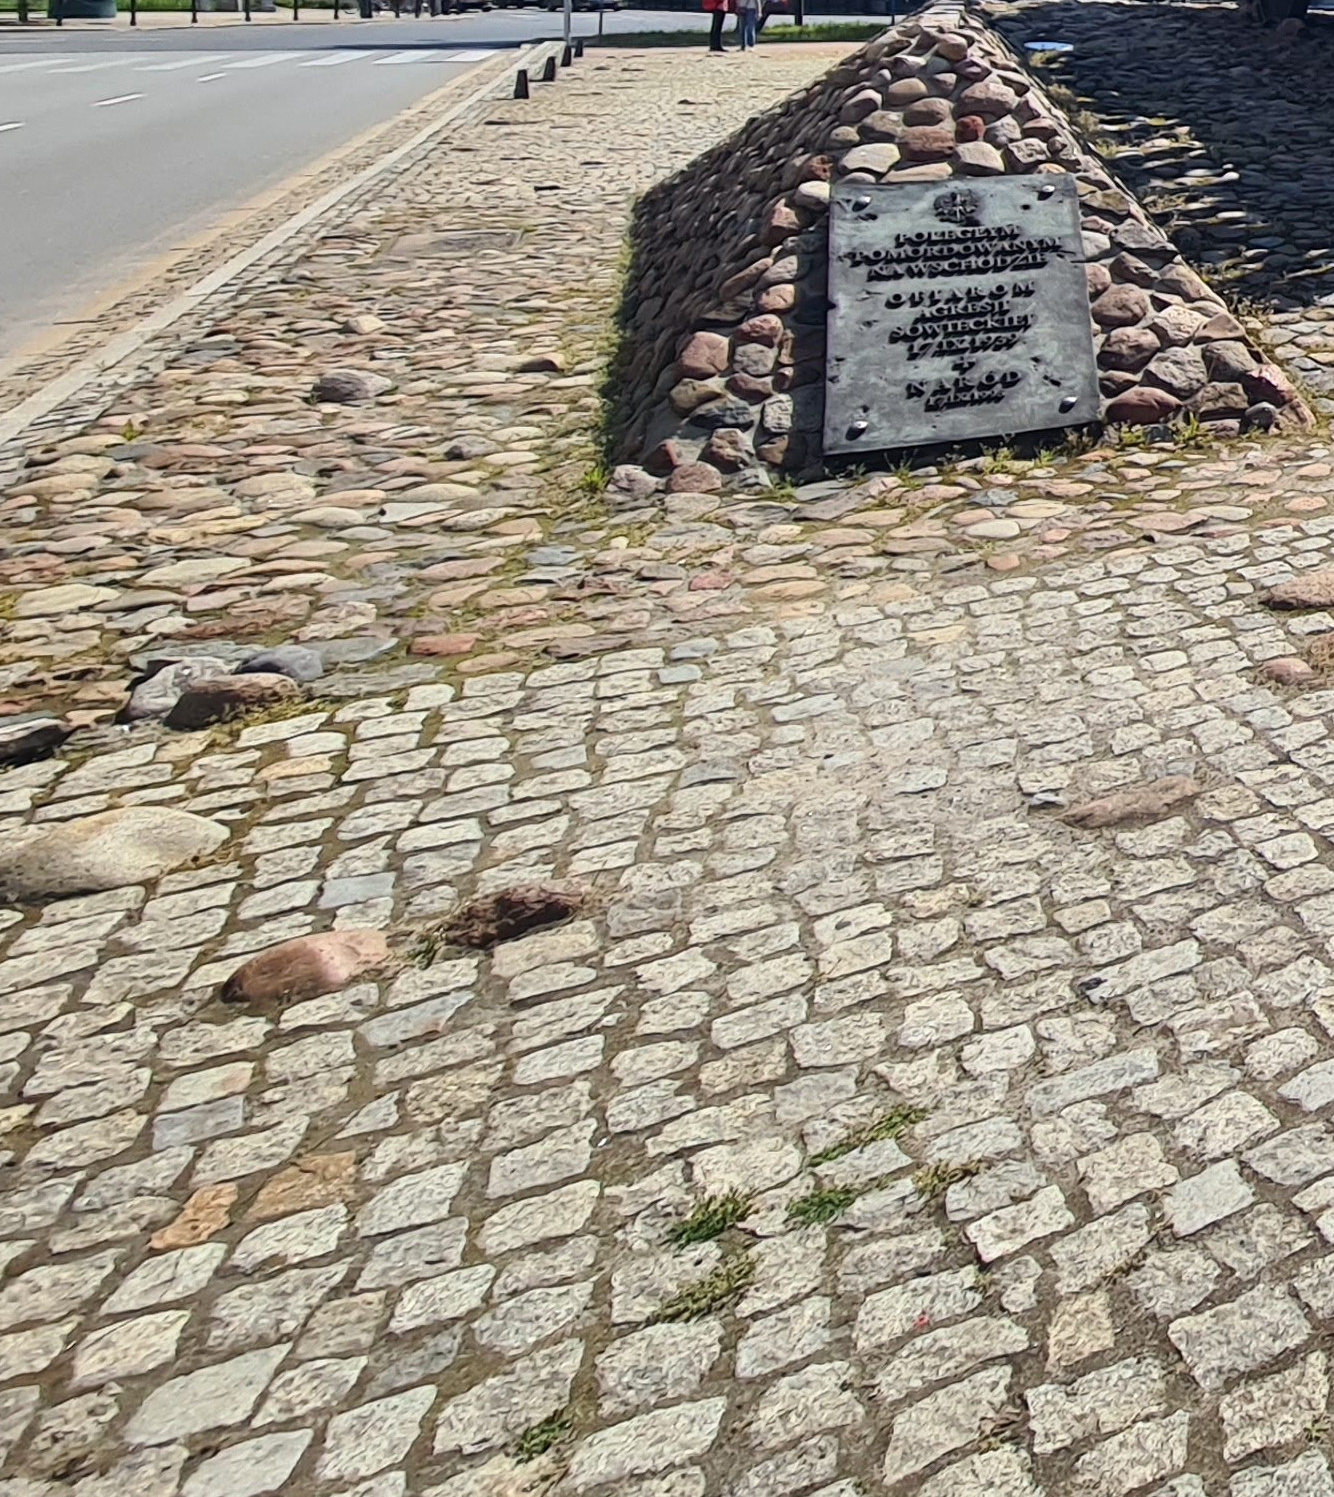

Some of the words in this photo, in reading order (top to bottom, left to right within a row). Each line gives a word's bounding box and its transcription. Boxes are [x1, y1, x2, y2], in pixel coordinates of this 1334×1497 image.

[853, 236, 1062, 263] POMORDOWANYM
[909, 252, 1049, 275] WSCHODZIE
[887, 281, 1035, 305] OFIAROM
[890, 313, 1035, 339] SOWIECKIEJ
